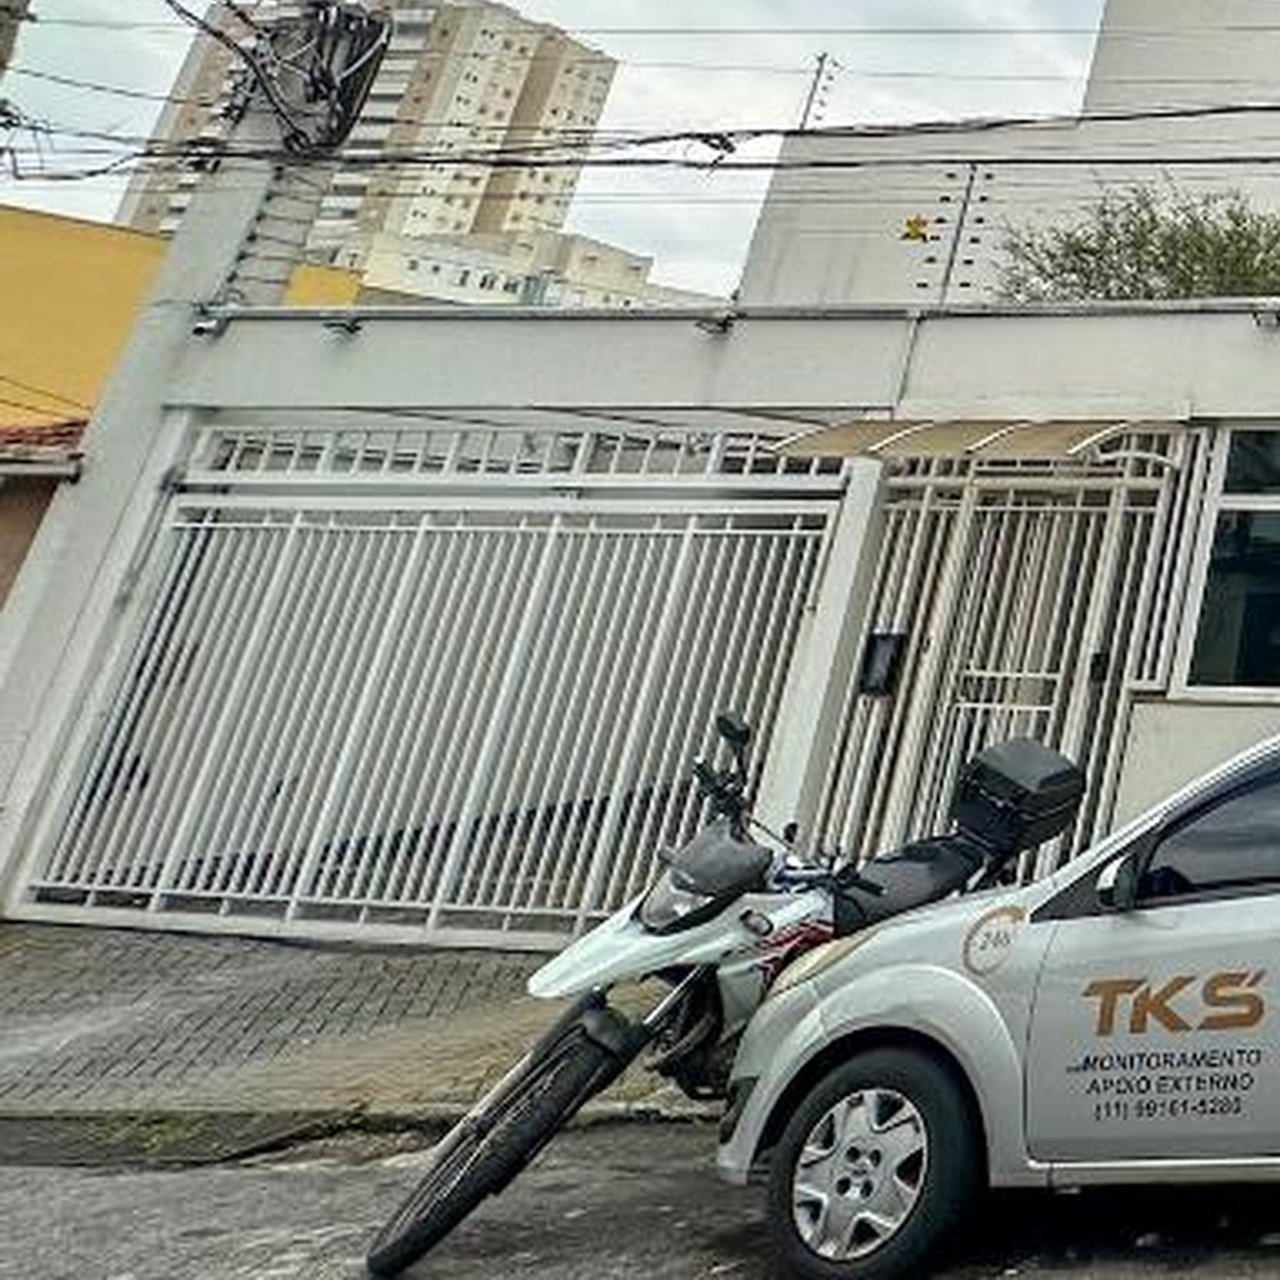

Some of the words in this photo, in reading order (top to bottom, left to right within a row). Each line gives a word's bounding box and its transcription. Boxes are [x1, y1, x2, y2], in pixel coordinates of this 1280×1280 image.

[1082, 970, 1267, 1037] TKS
[1081, 1049, 1262, 1072] MONITORAMENTO
[1086, 1076, 1151, 1095] APOIO
[1156, 1072, 1255, 1094] EXTERNO
[1095, 1099, 1128, 1120] (11)
